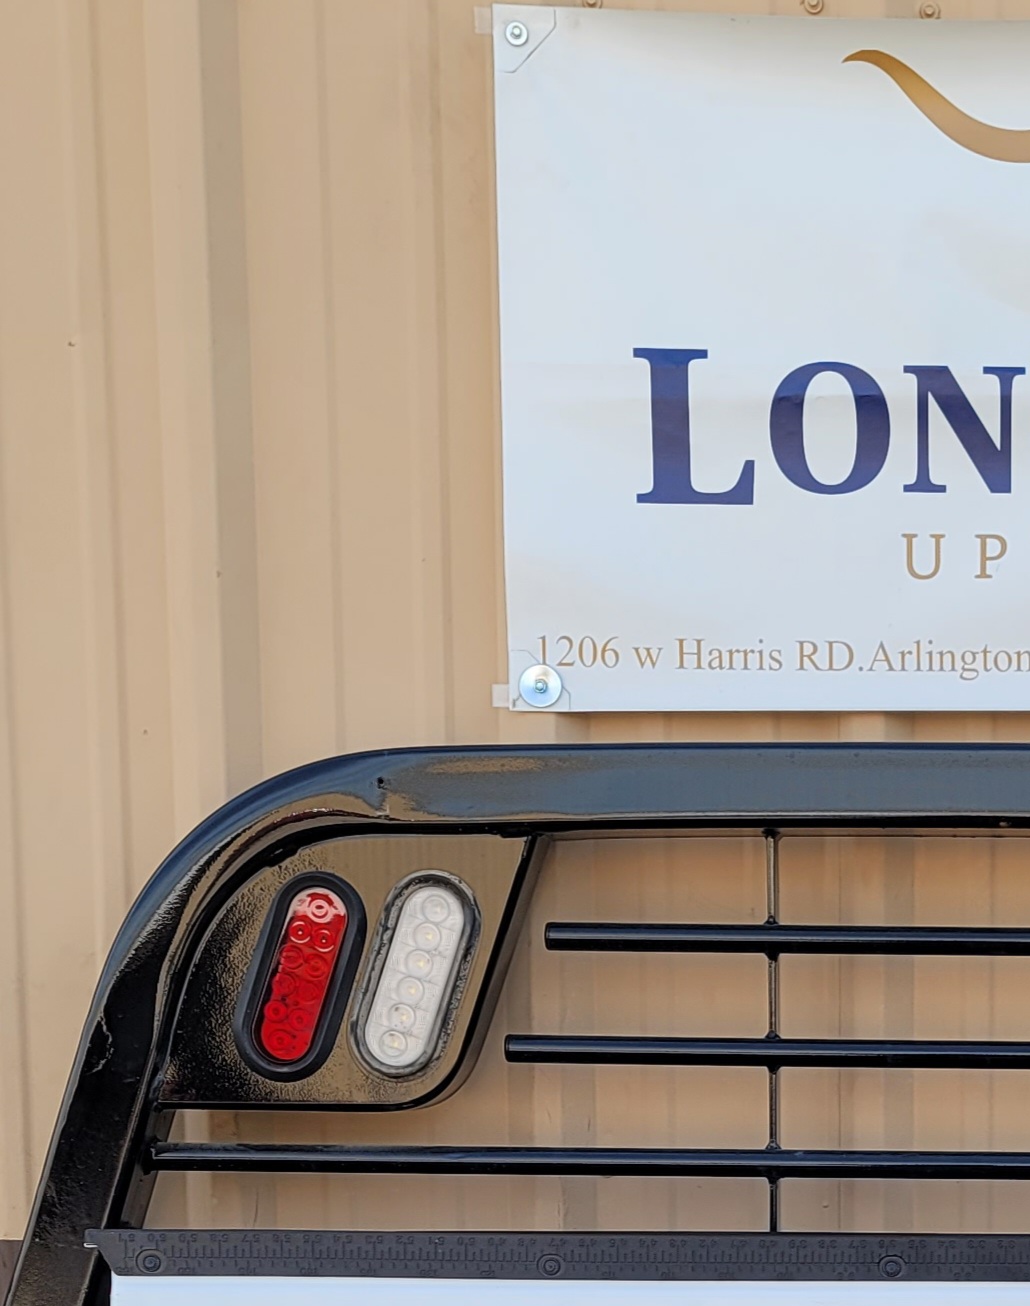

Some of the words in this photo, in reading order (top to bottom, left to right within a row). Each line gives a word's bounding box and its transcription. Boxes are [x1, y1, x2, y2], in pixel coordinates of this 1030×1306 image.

[536, 635, 620, 668] 1206
[632, 647, 663, 668] w
[677, 638, 783, 671] Harris
